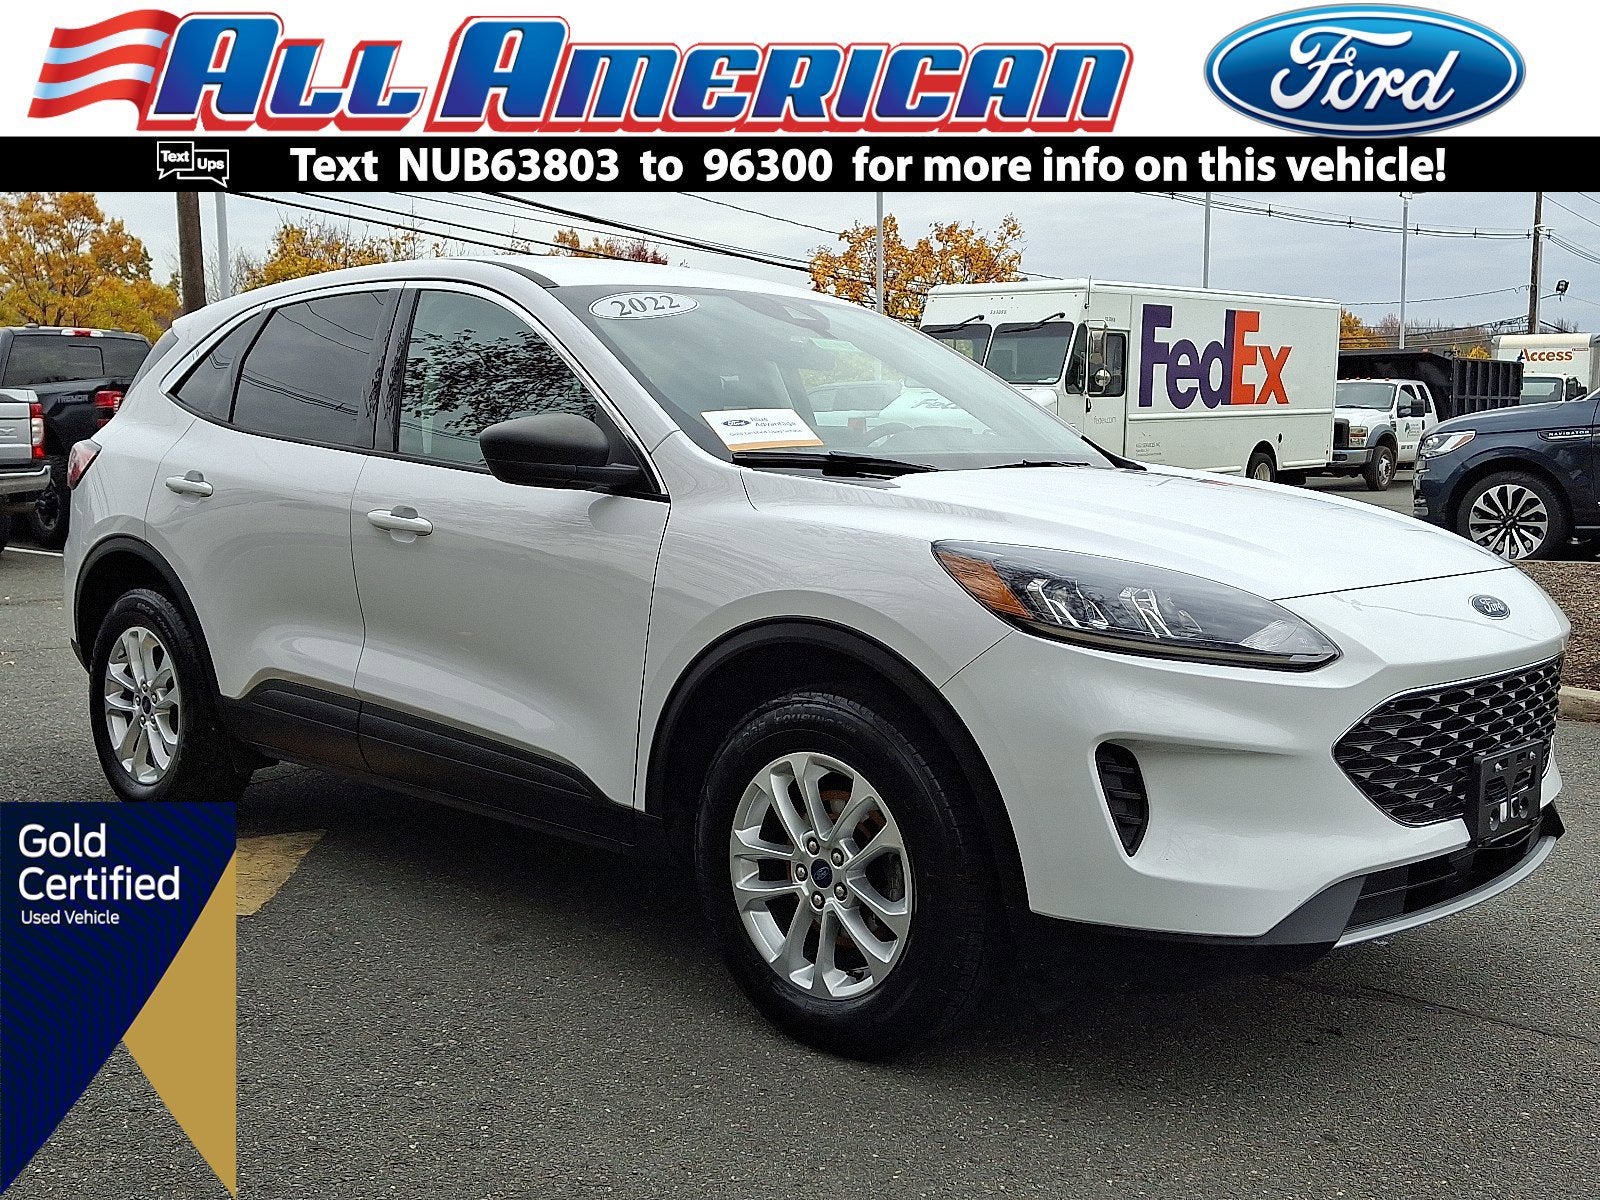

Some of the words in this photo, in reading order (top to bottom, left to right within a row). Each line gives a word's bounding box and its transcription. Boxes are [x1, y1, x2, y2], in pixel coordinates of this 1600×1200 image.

[610, 295, 680, 316] 2022
[1139, 303, 1293, 410] FedEx
[1518, 348, 1573, 362] Access
